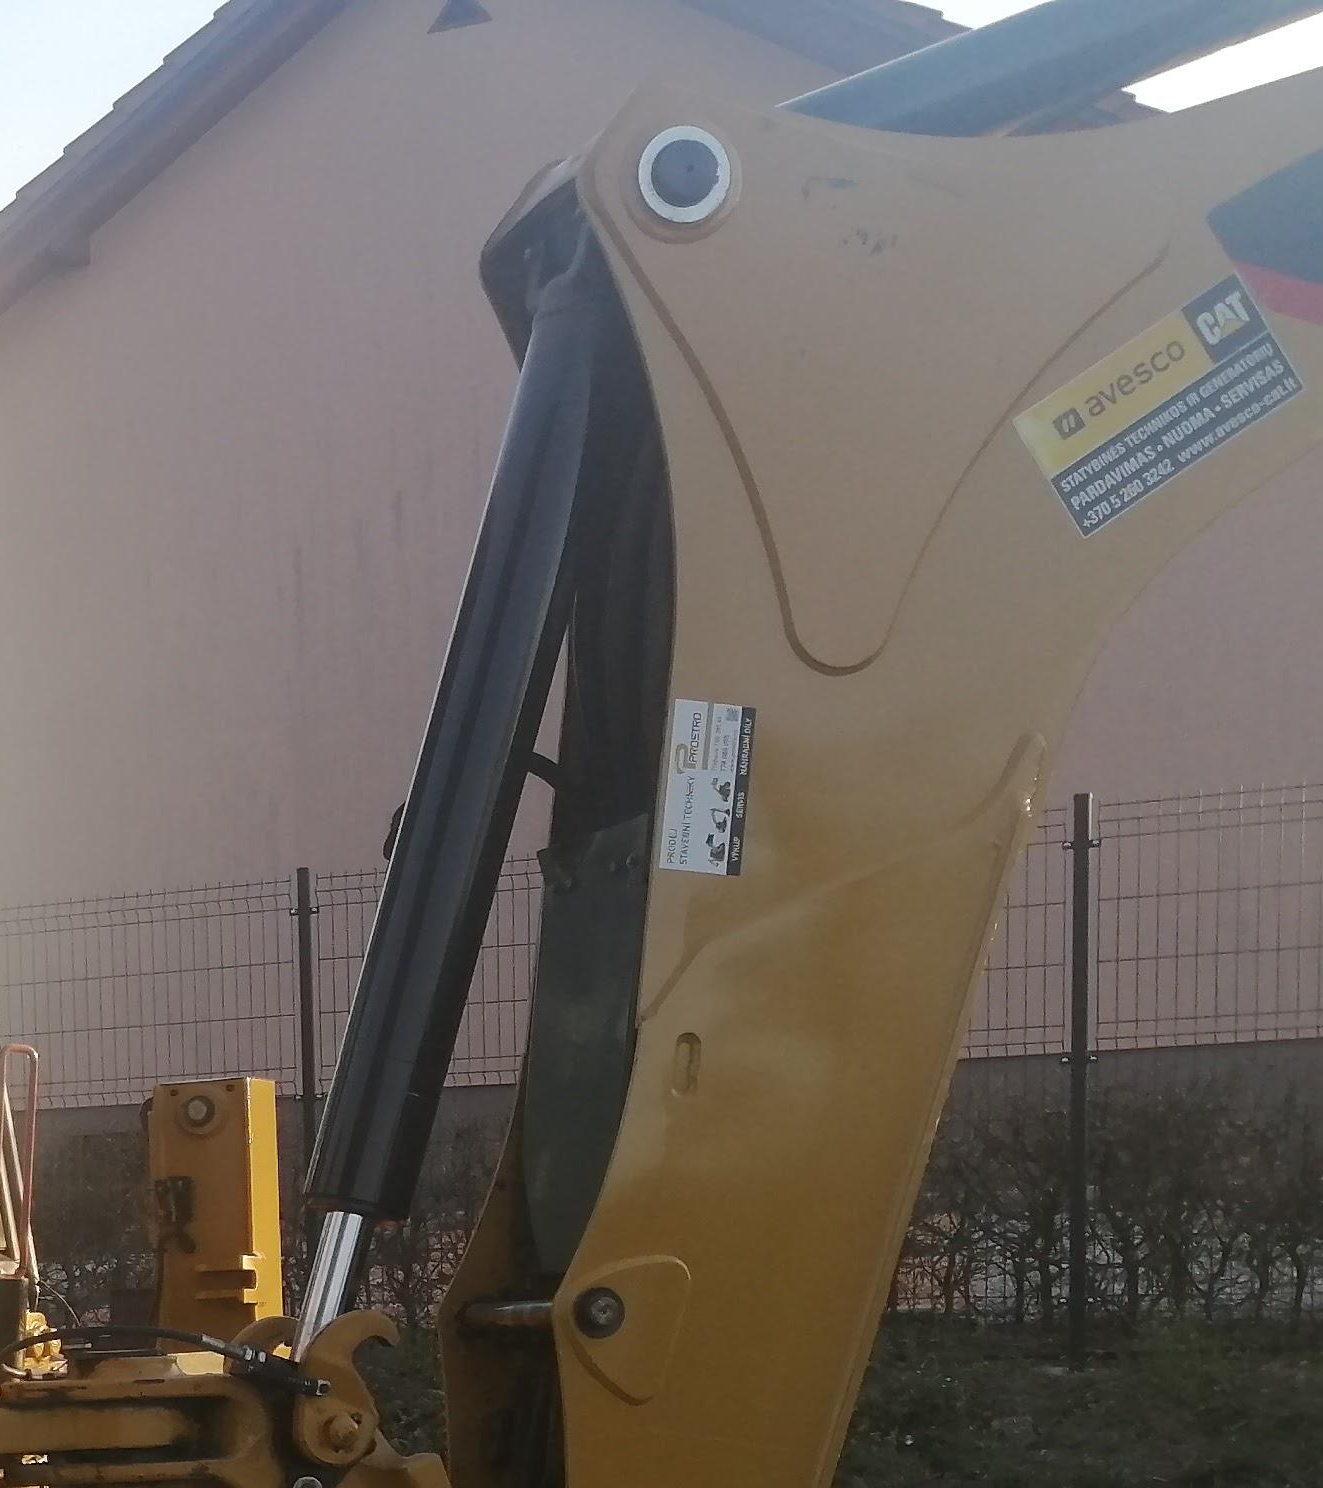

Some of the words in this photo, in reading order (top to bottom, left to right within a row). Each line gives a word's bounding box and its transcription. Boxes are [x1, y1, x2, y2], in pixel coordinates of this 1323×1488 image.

[1196, 291, 1251, 346] CAT
[1085, 340, 1186, 417] avesco
[1071, 445, 1157, 511] PARDAVIMAS
[1161, 407, 1217, 449] NUOMA
[1220, 359, 1285, 409] SERVISAS
[1082, 500, 1112, 528] +370
[1109, 494, 1122, 509] 5
